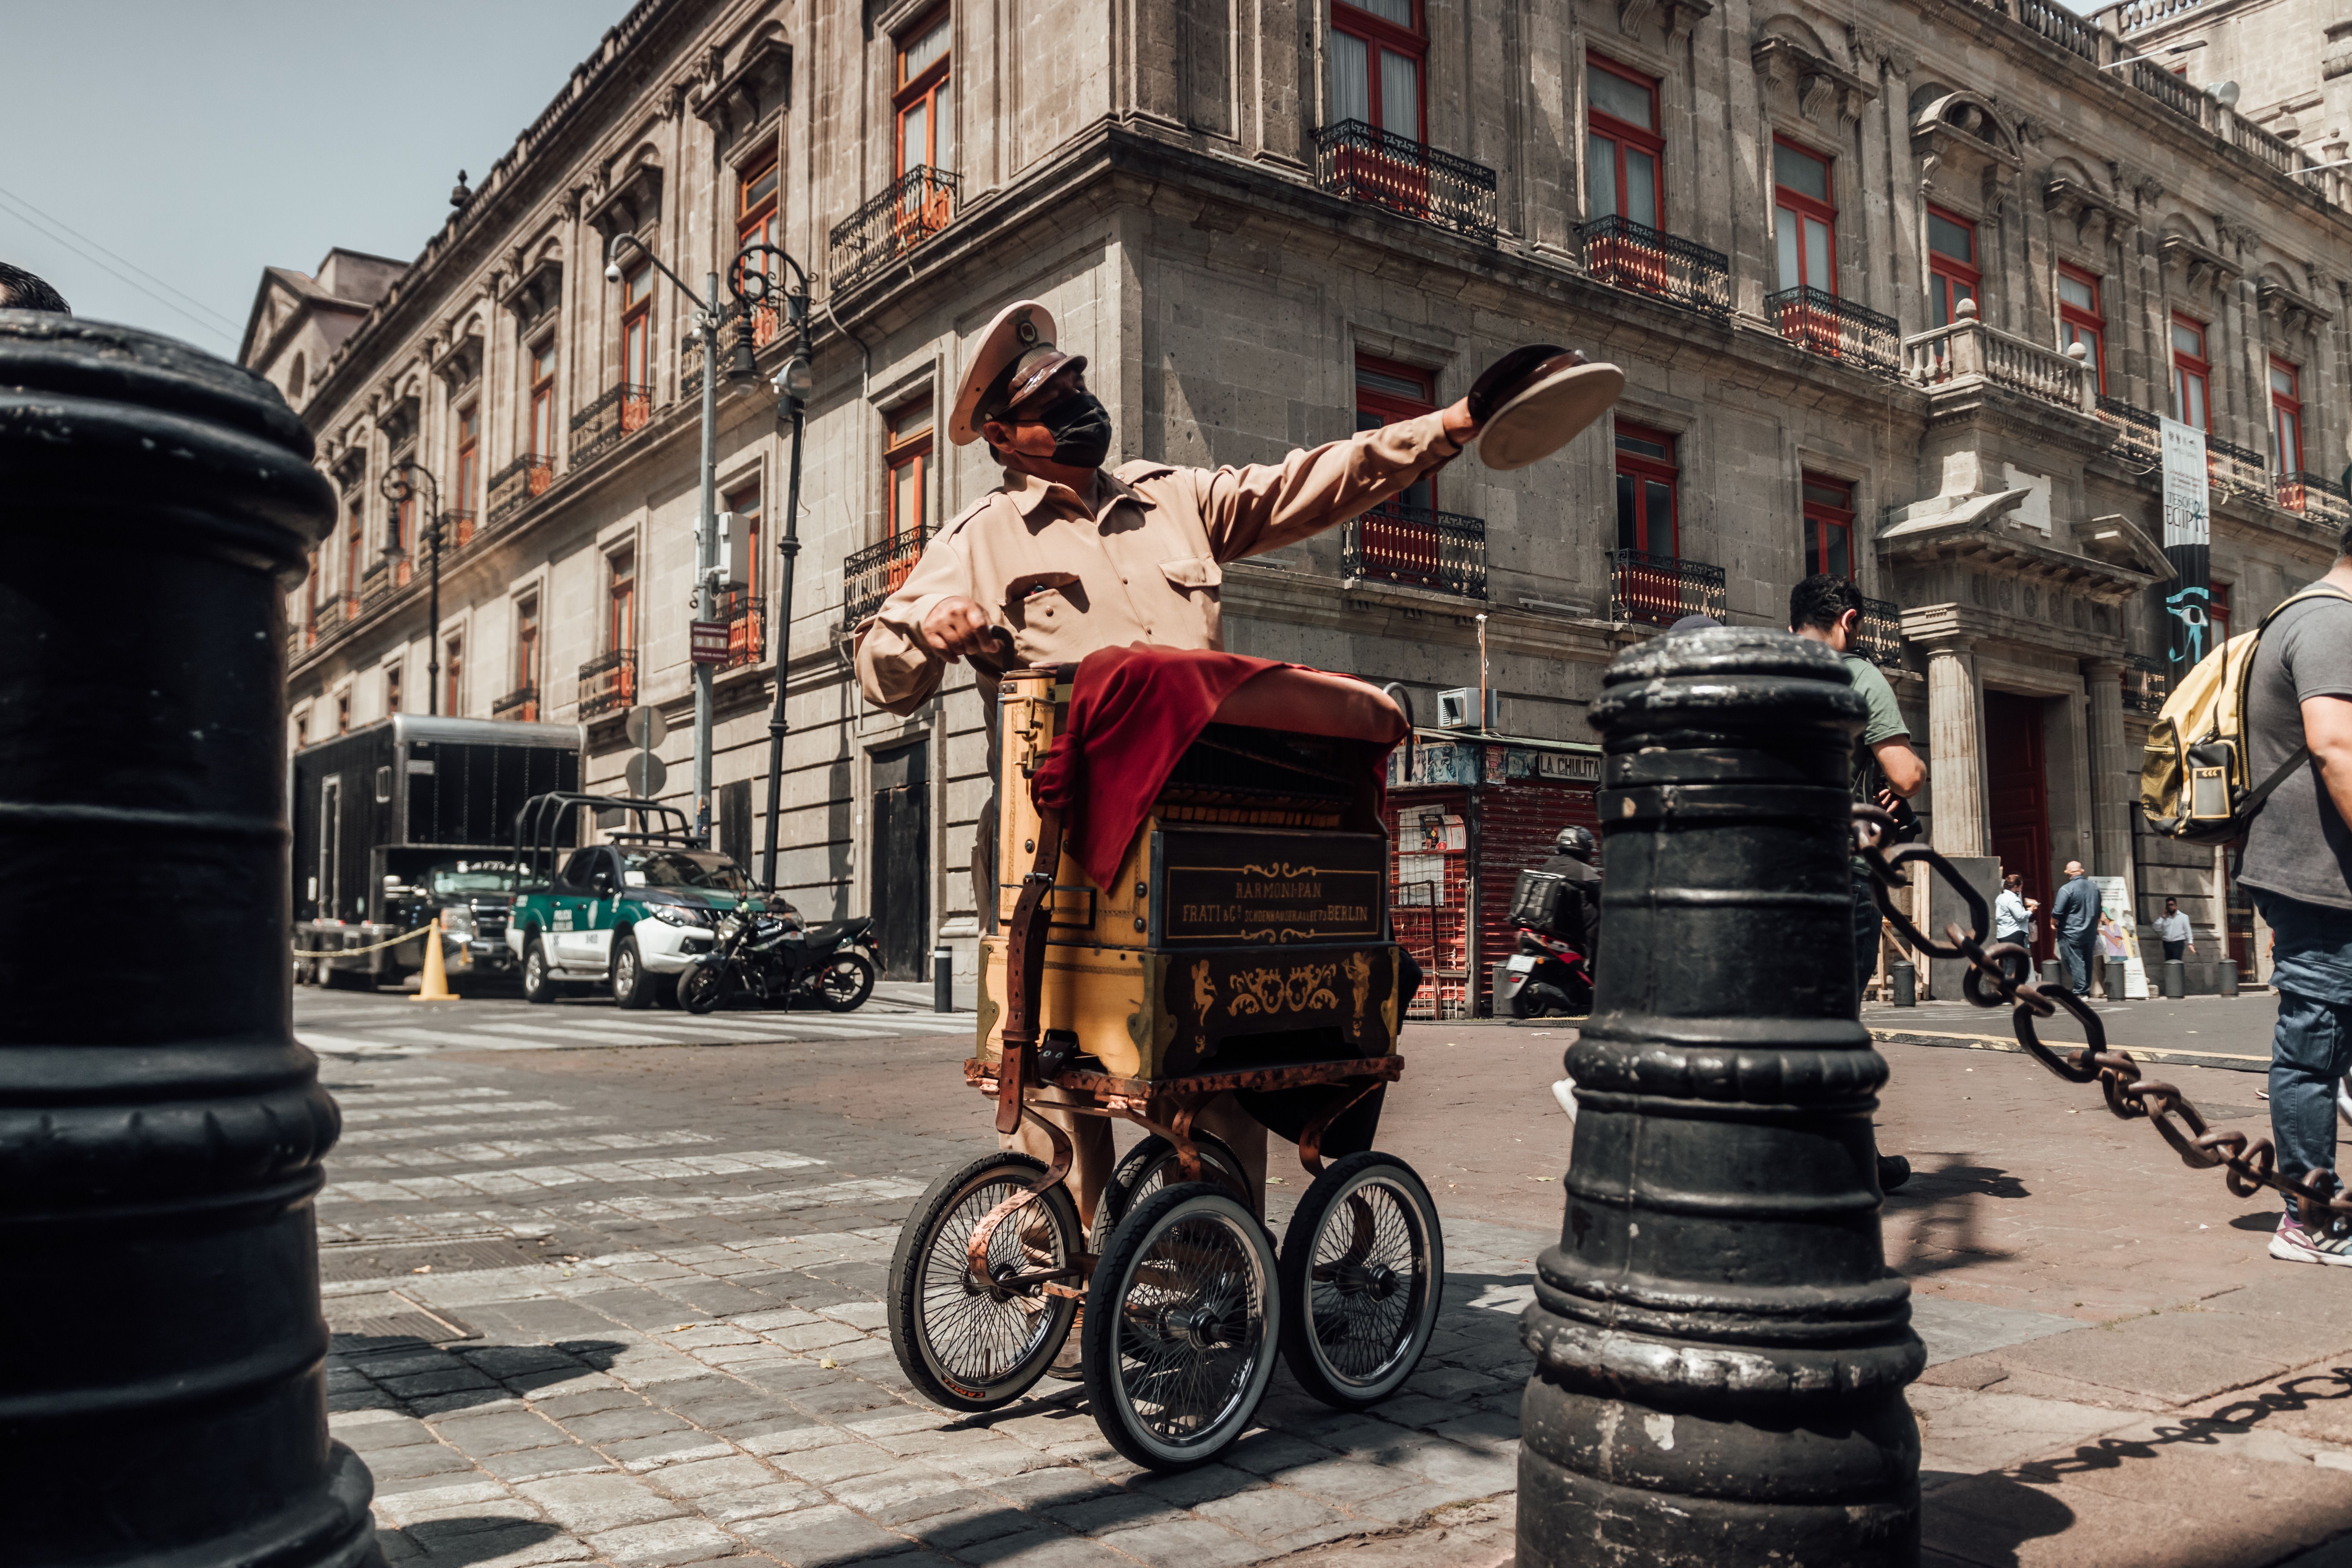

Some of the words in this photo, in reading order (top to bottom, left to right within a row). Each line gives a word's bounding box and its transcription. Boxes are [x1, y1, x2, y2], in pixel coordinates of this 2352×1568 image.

[1540, 755, 1554, 773] LA
[1557, 757, 1601, 777] CHULITA
[1183, 904, 1220, 922] FRATI
[1328, 905, 1368, 921] BERLIN
